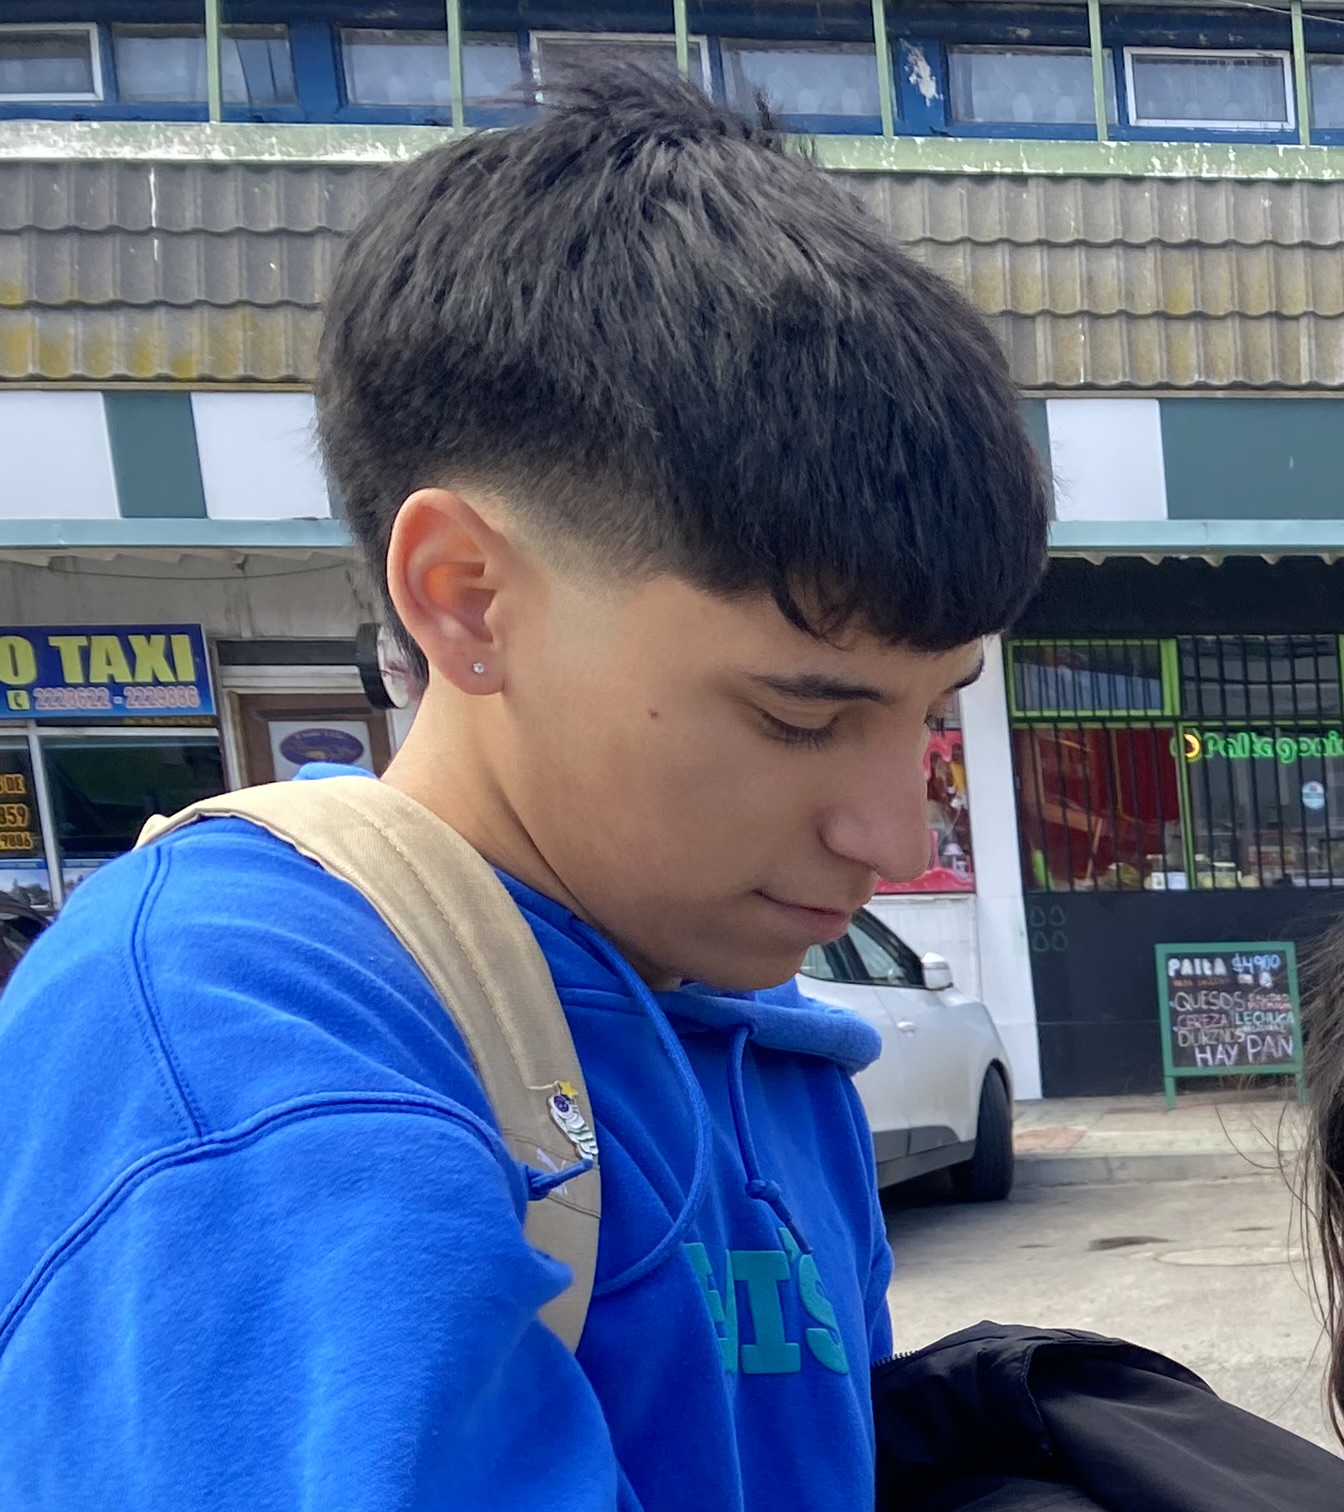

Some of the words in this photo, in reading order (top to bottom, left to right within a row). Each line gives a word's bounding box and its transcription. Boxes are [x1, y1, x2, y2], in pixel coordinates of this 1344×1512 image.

[48, 634, 196, 684] TAXI
[1174, 990, 1246, 1012] QUESOS
[1194, 1043, 1239, 1067] HAY
[1246, 1034, 1294, 1063] PAN
